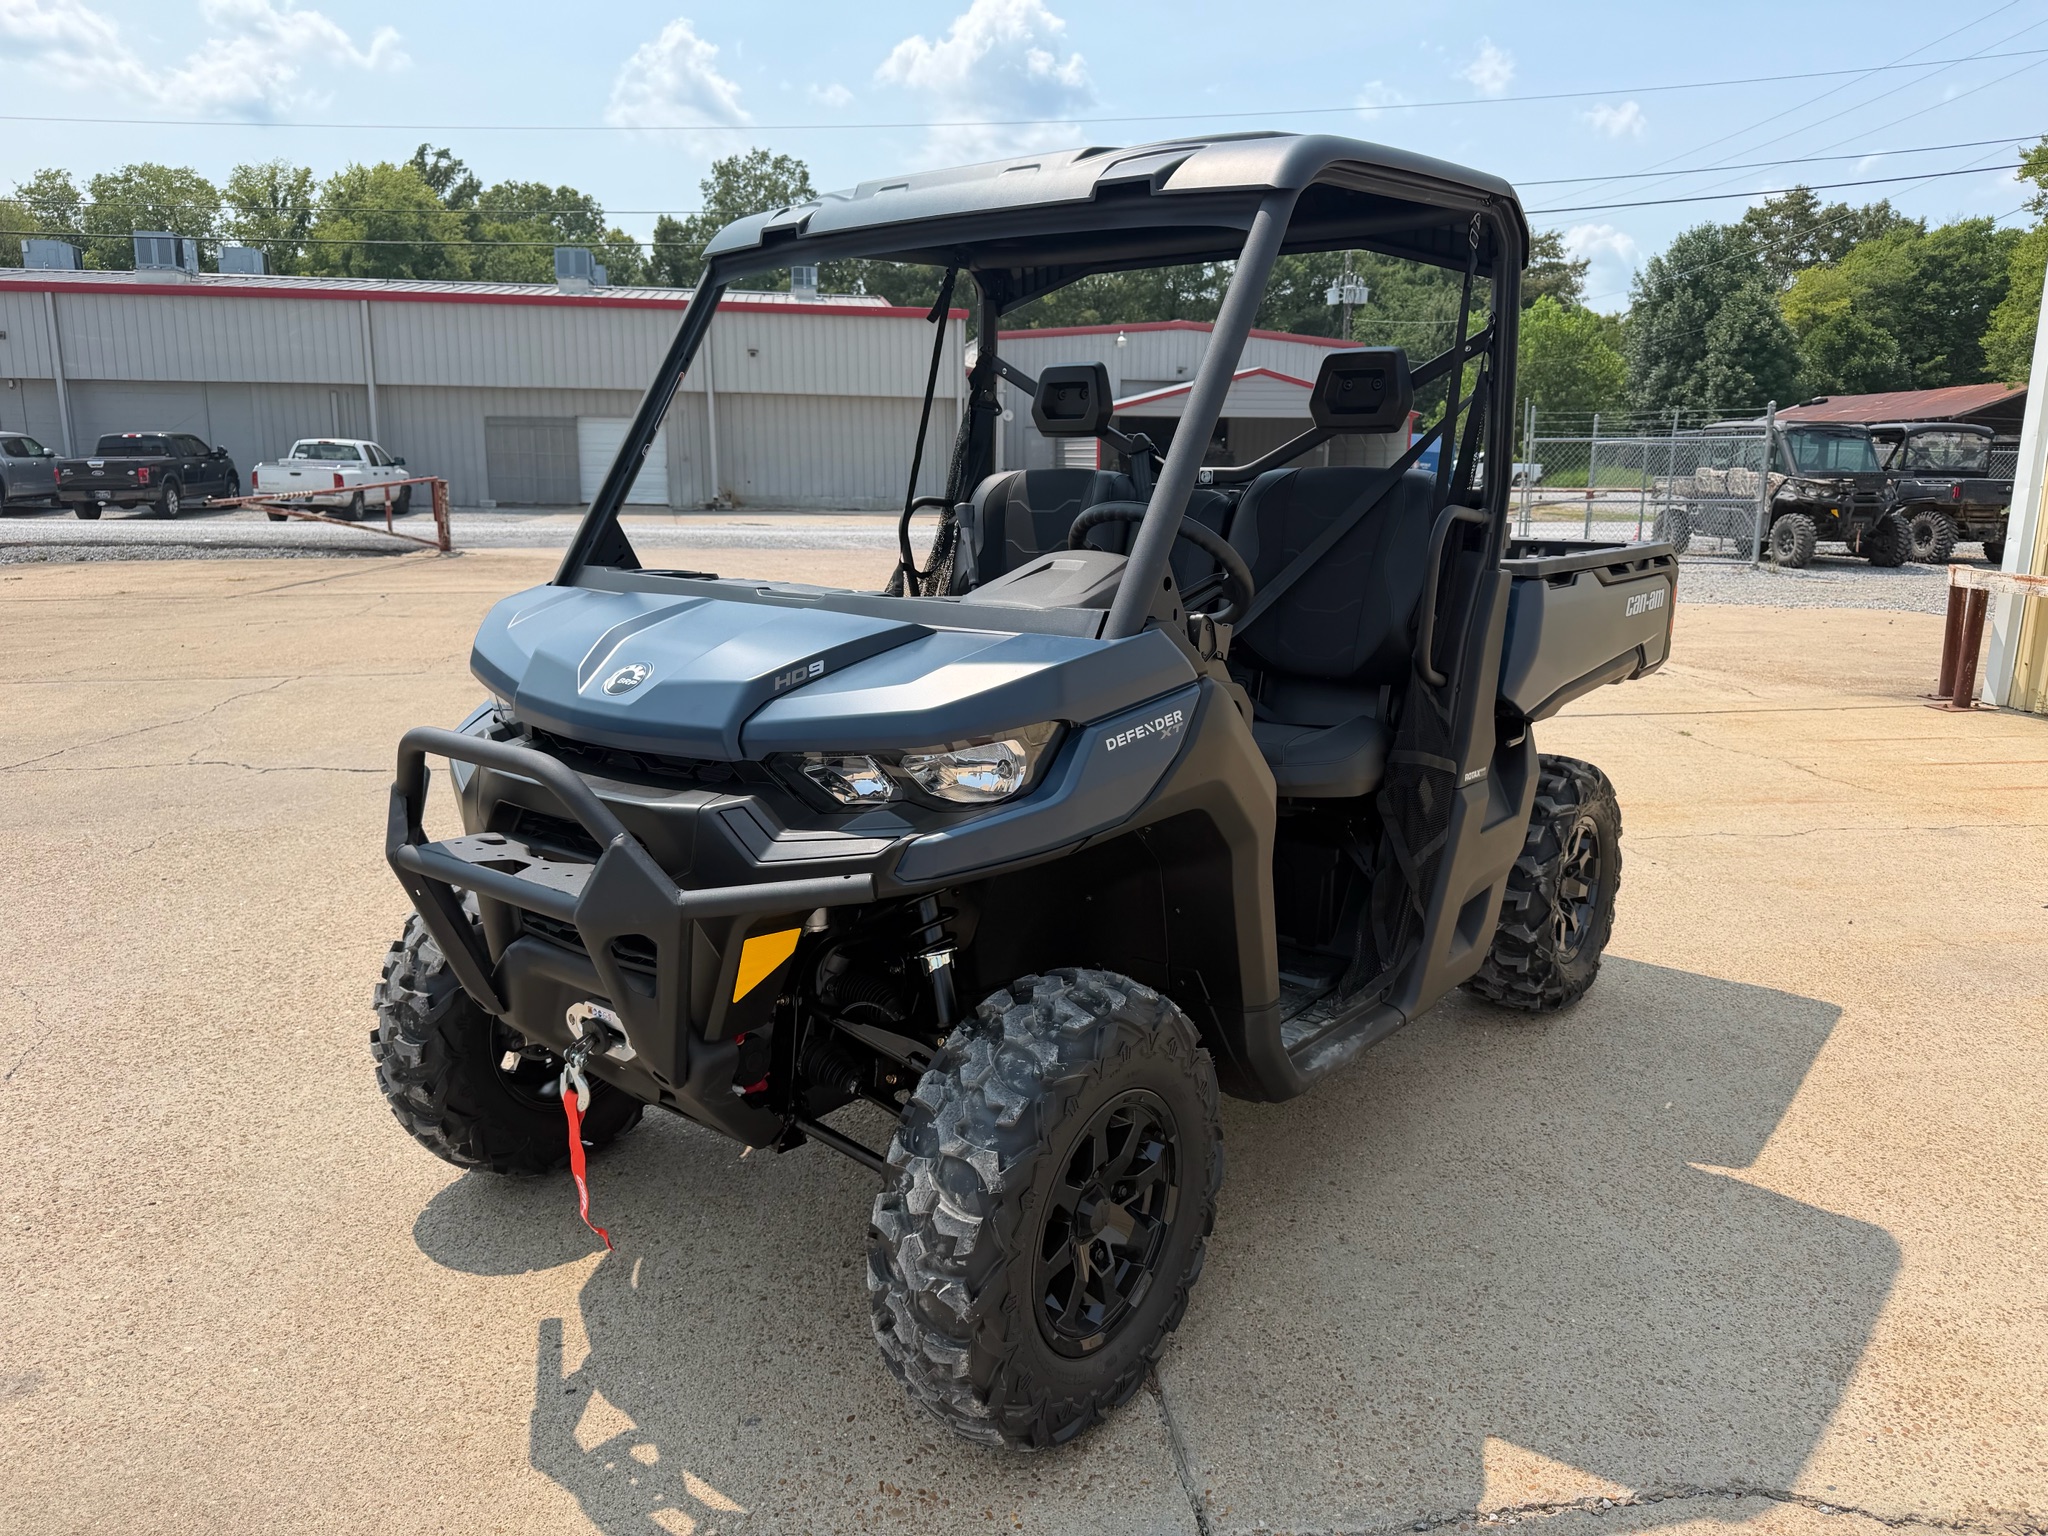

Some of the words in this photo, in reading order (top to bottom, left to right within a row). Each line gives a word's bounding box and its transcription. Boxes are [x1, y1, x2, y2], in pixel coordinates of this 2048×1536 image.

[617, 677, 638, 686] BRP
[774, 660, 825, 690] HD9
[1105, 710, 1183, 751] DEFENDER
[1160, 722, 1183, 740] XT
